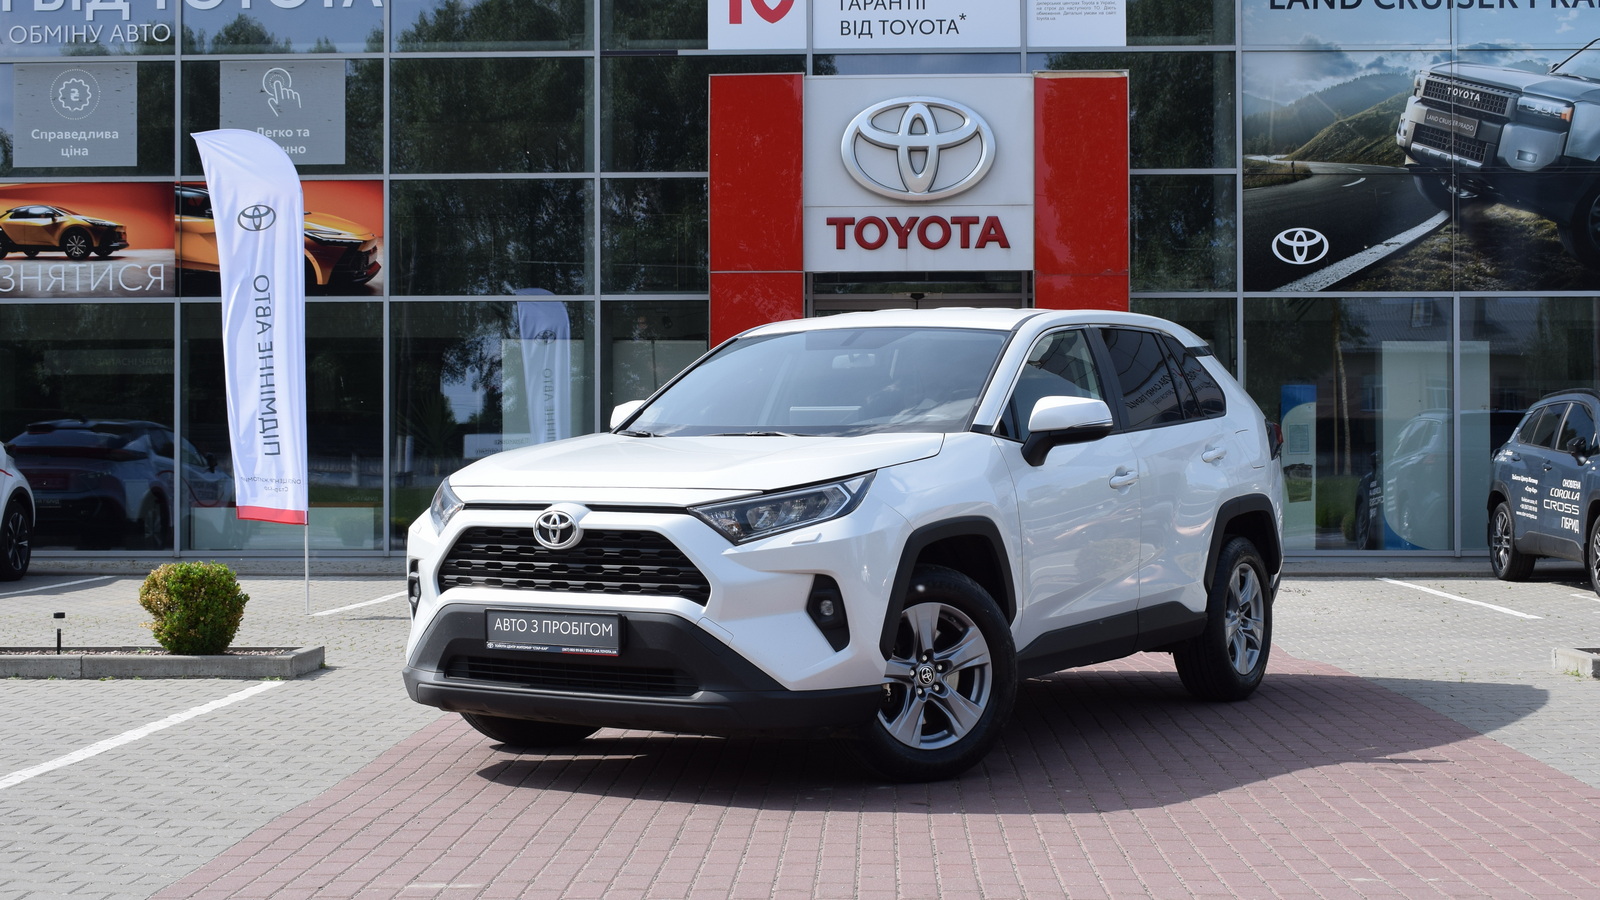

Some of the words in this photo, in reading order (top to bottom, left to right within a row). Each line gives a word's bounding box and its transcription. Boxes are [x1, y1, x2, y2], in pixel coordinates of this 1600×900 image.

[9, 24, 104, 44] ОБМІНУ
[110, 23, 171, 42] АВТО
[840, 20, 873, 39] ВІД
[1447, 88, 1480, 102] TOYOTA
[31, 129, 119, 142] Справедлива
[257, 127, 293, 137] Легко
[296, 129, 310, 137] та
[61, 145, 89, 157] ціна
[826, 216, 1011, 250] TOYOTA
[1550, 488, 1580, 501] COROLLA
[1543, 499, 1579, 515] CROSS
[494, 618, 527, 632] АВТО
[531, 620, 538, 633] З
[542, 620, 613, 637] ПРОБІГОМ
